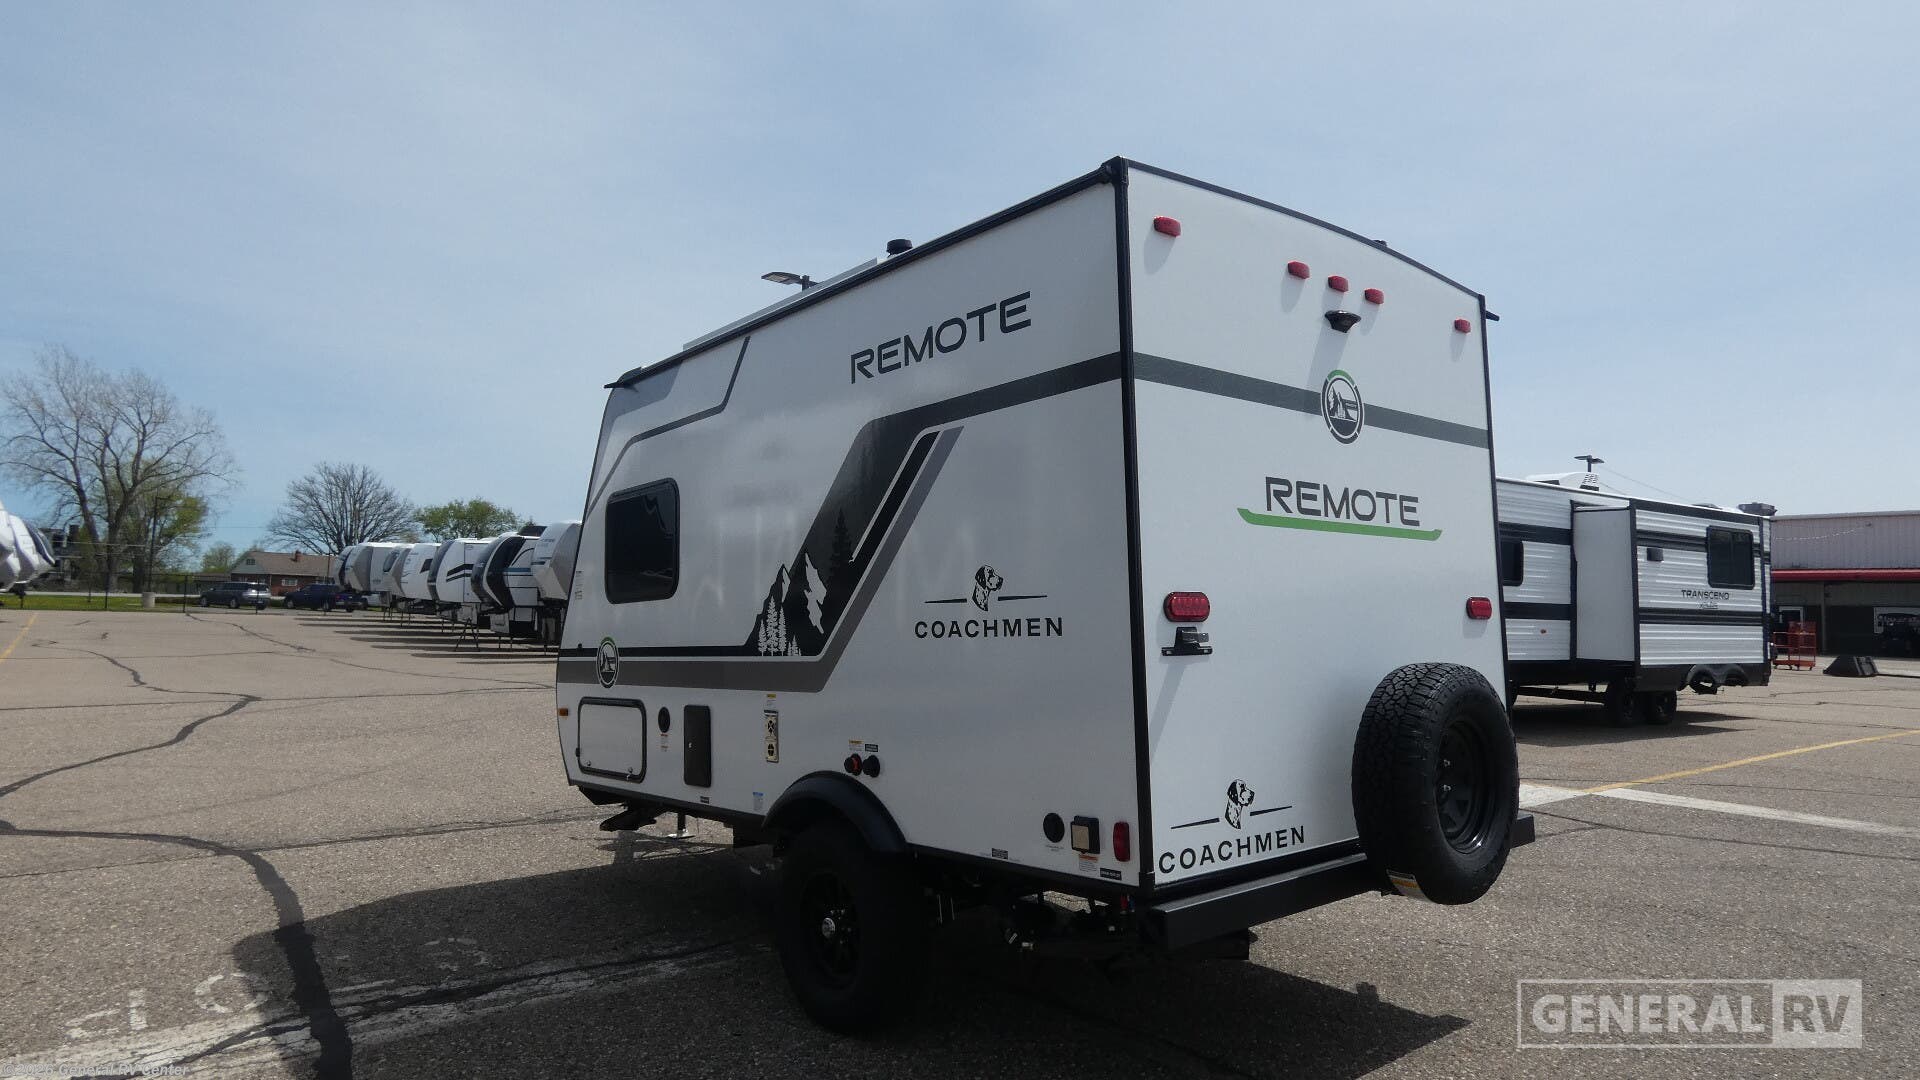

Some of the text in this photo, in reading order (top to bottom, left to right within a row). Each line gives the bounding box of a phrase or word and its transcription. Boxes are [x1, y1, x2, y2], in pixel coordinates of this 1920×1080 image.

[850, 290, 1031, 384] REMOTE
[1265, 476, 1420, 527] REMOTE
[914, 617, 1063, 639] COACHMEN
[1158, 825, 1305, 874] COACHMEN
